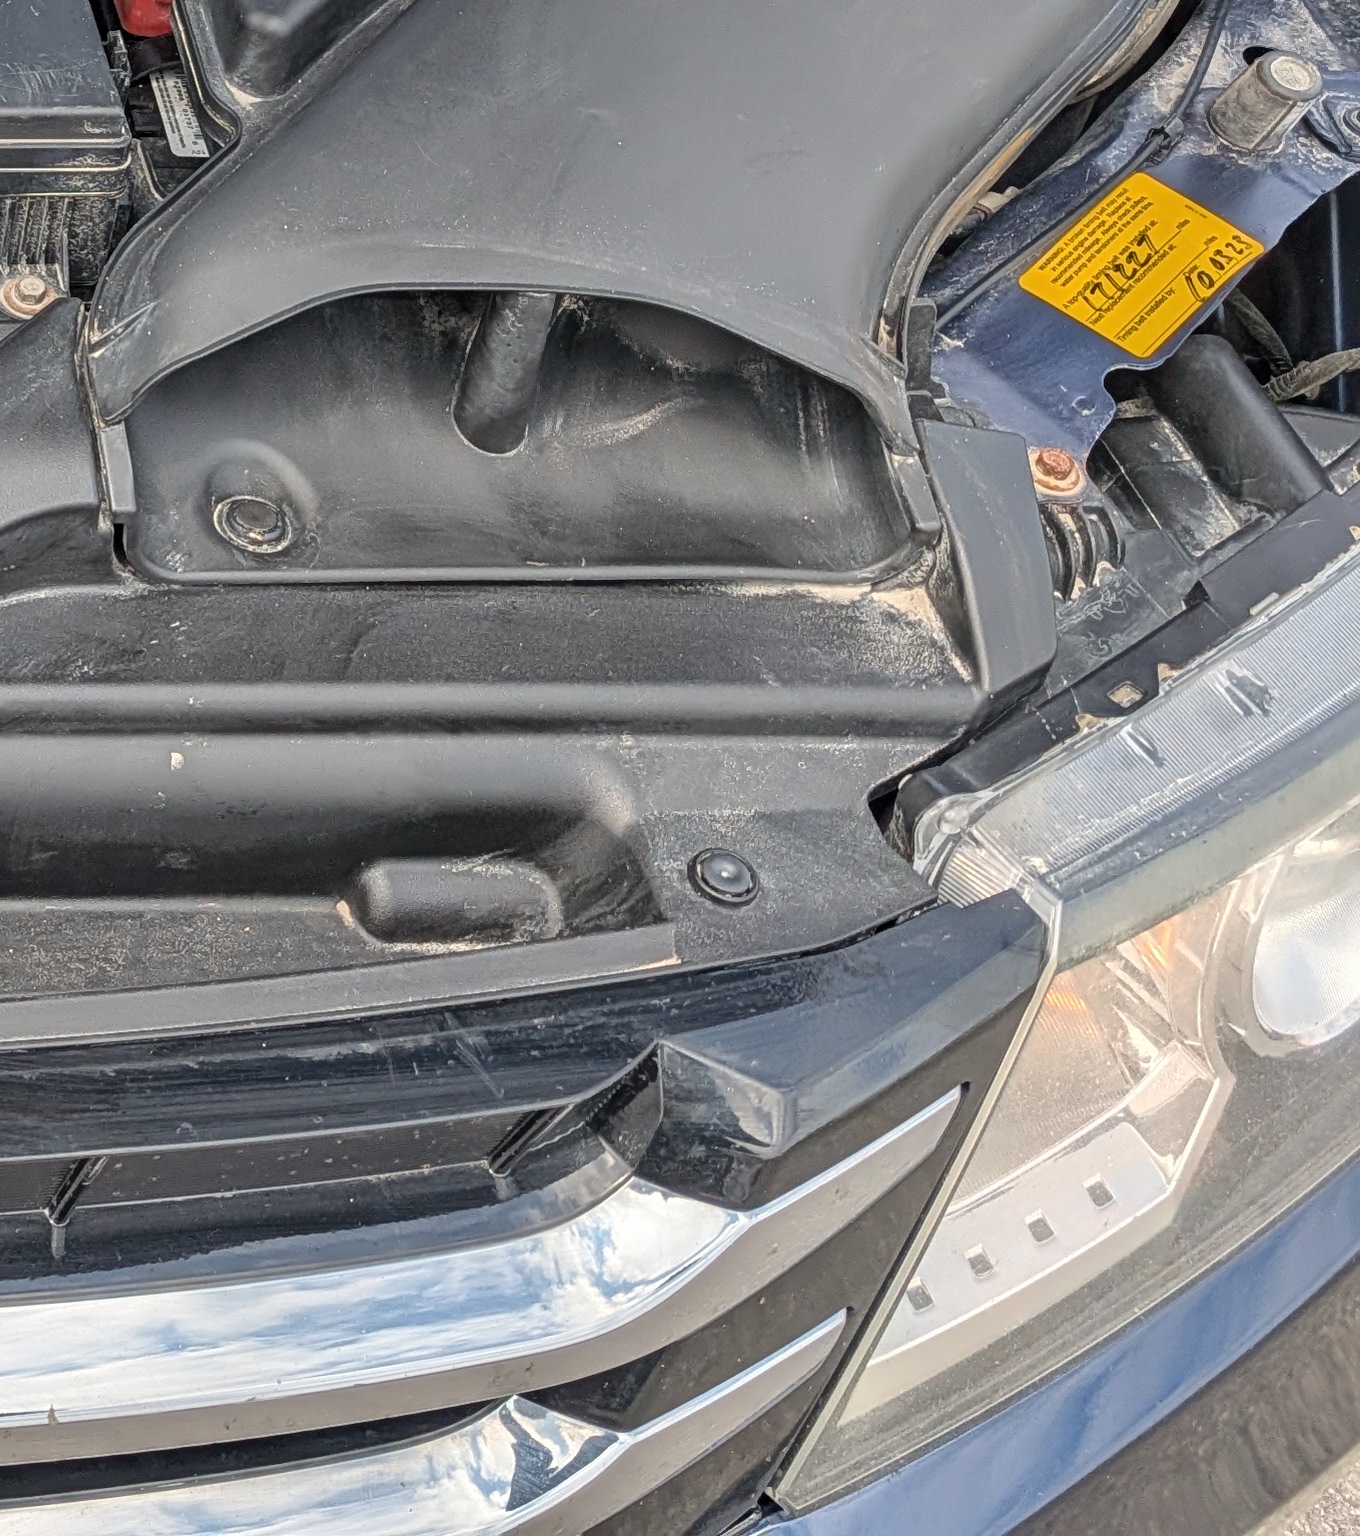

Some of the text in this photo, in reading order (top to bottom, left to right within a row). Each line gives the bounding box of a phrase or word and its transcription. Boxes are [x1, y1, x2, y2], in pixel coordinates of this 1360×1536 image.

[1117, 325, 1139, 342] Timing
[1134, 315, 1148, 327] belt
[1144, 294, 1168, 317] installed
